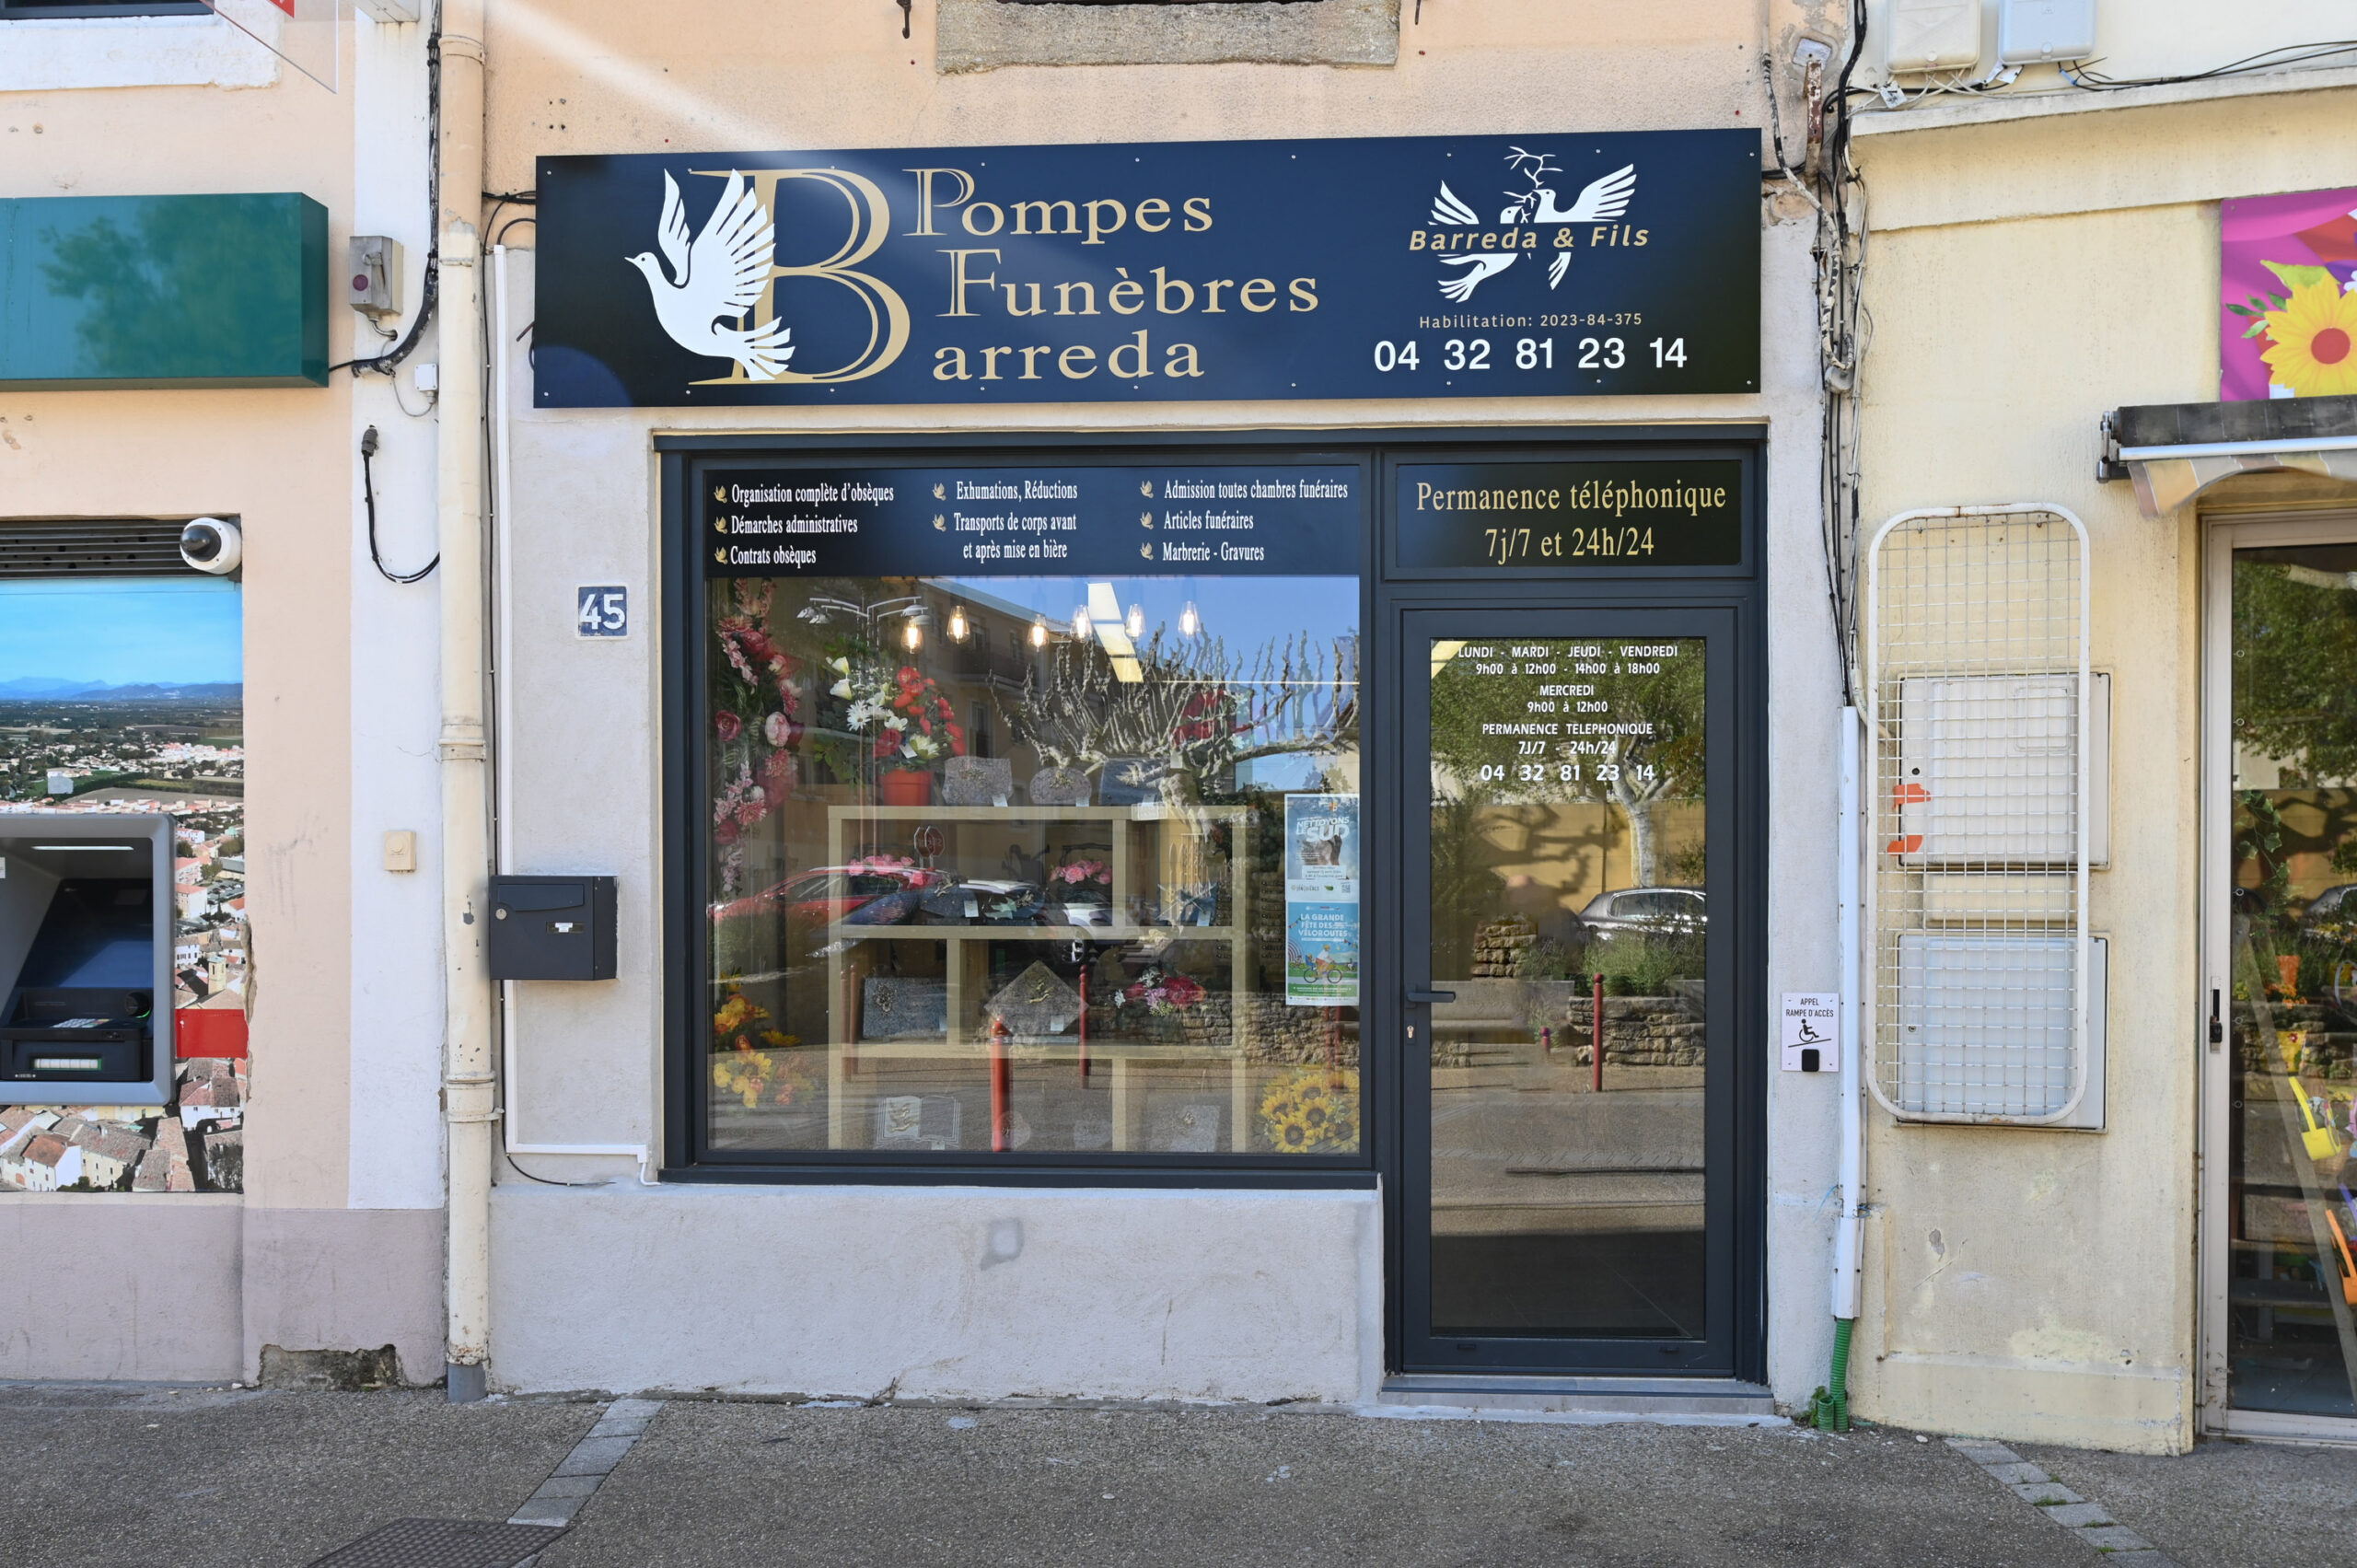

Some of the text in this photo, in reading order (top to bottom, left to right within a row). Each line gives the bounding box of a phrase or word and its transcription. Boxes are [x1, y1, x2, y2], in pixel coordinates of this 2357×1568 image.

[901, 168, 1213, 245] Pompes
[1409, 225, 1650, 250] Barreda & Fils
[688, 168, 911, 386] B
[935, 248, 1319, 317] Funèbres
[1419, 312, 1643, 329] Habilitation: 2023-84-375
[932, 329, 1205, 381] arreda
[1374, 337, 1688, 372] 04 32 81 23 14
[732, 482, 894, 507] Organisation complète d'obsèques
[957, 480, 1078, 503] Exhumations, Réductions
[1164, 479, 1348, 499] Admission toutes chambres funéraires
[1416, 479, 1726, 517] Permanence téléphonique
[731, 514, 858, 534] Démarches administratives
[954, 511, 1077, 536] Transports de corps avant
[1164, 510, 1254, 529] Articles funéraires
[962, 540, 1068, 563] et après mise en bière
[1162, 542, 1211, 562] Marbrerie
[1221, 542, 1264, 561] Gravures
[1484, 526, 1655, 564] 7j/7 et 24h/24
[730, 545, 817, 569] Contrats obsèques
[579, 594, 625, 630] 45
[1457, 646, 1493, 658] LUNDI
[1511, 645, 1549, 658] MARDI
[1567, 645, 1601, 657] JEUDI
[1620, 645, 1678, 657] VENDREDI
[1475, 663, 1504, 675] 9h00
[1511, 663, 1518, 674] à
[1525, 663, 1556, 675] 12h00
[1574, 663, 1607, 675] 14h00
[1613, 663, 1620, 674] à
[1627, 662, 1660, 674] 18h00
[1539, 684, 1595, 696] MERCREDI
[1527, 701, 1608, 714] 9h00 à 12h00
[1482, 723, 1654, 736] PERMANENCE TELEPHONIQUE
[1518, 740, 1546, 755] 7J/7
[1570, 740, 1617, 755] 24h/24
[1480, 764, 1655, 782] 04 32 81 23 14
[1296, 816, 1350, 830] NETTOYONS
[1306, 824, 1350, 842] SUD
[1301, 920, 1317, 929] FÊTE
[1312, 913, 1344, 922] GRANDE
[1298, 928, 1348, 937] VÉLOROUTES
[1800, 998, 1819, 1006] APPEL
[1785, 1008, 1834, 1017] RAMPE D'ACCÈS
